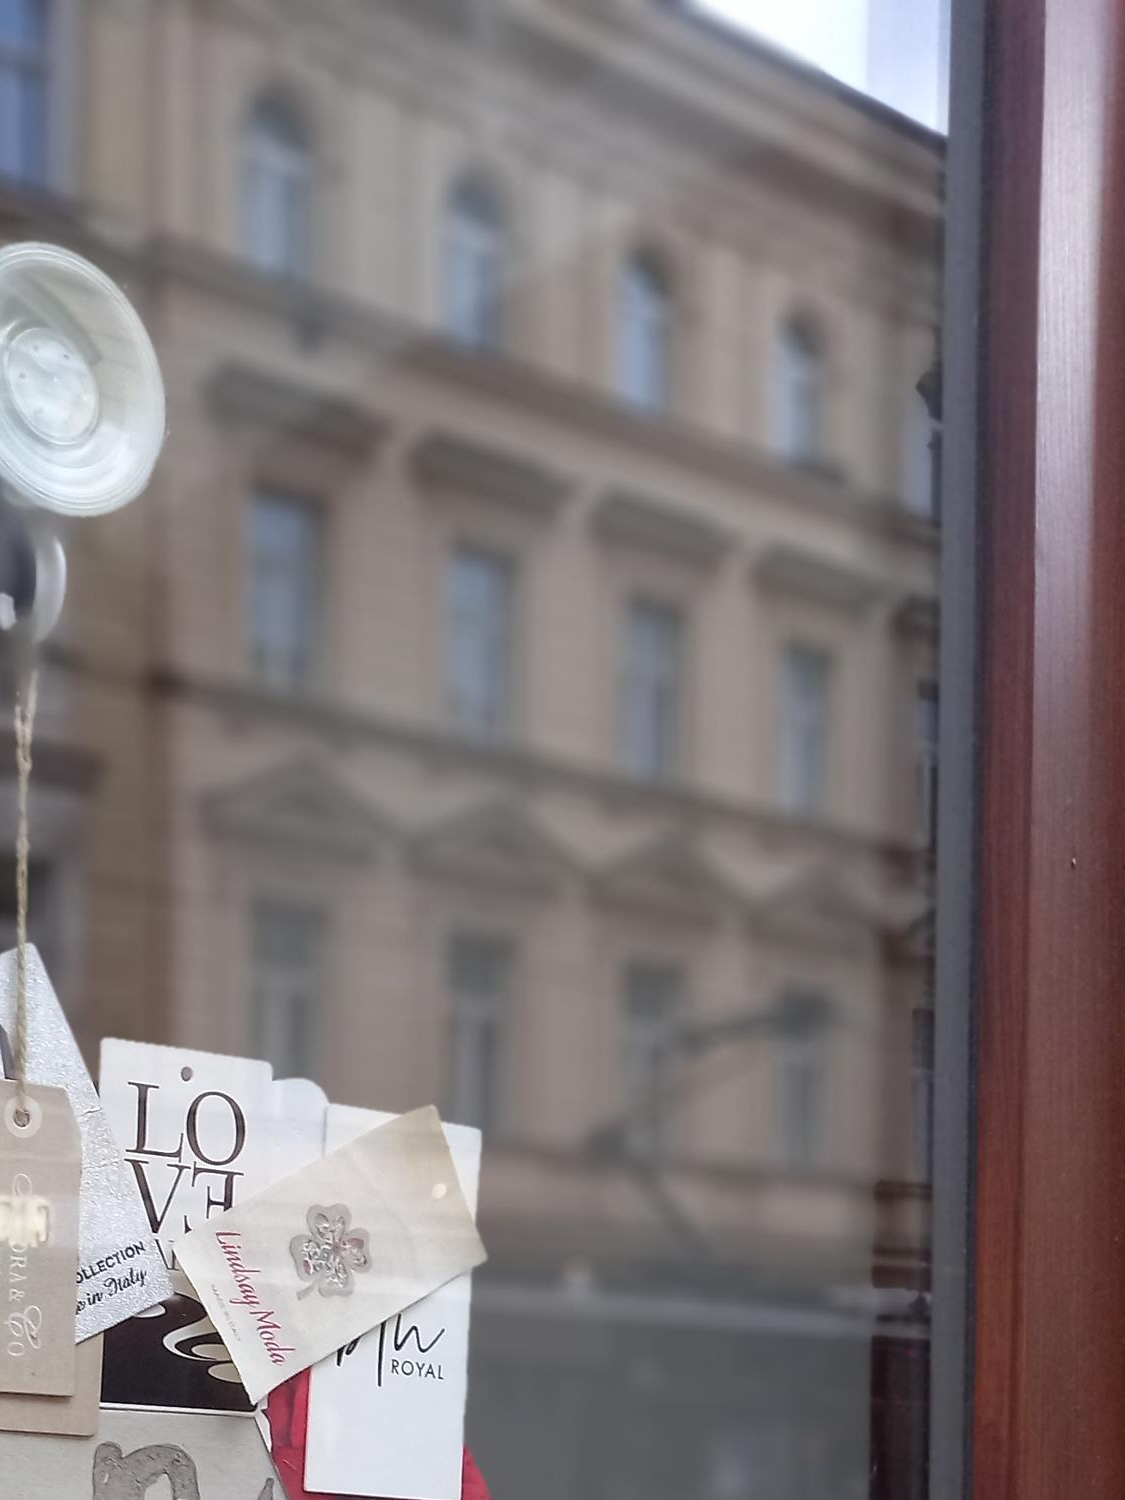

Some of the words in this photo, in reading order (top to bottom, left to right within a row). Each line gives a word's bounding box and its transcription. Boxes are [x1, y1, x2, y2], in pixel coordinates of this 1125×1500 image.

[125, 1082, 246, 1165] LO
[76, 1241, 146, 1284] OLLECTION
[103, 1267, 147, 1296] Italy
[215, 1232, 261, 1306] Lindsay
[249, 1310, 296, 1366] Moda
[391, 1359, 444, 1380] ROYAL
